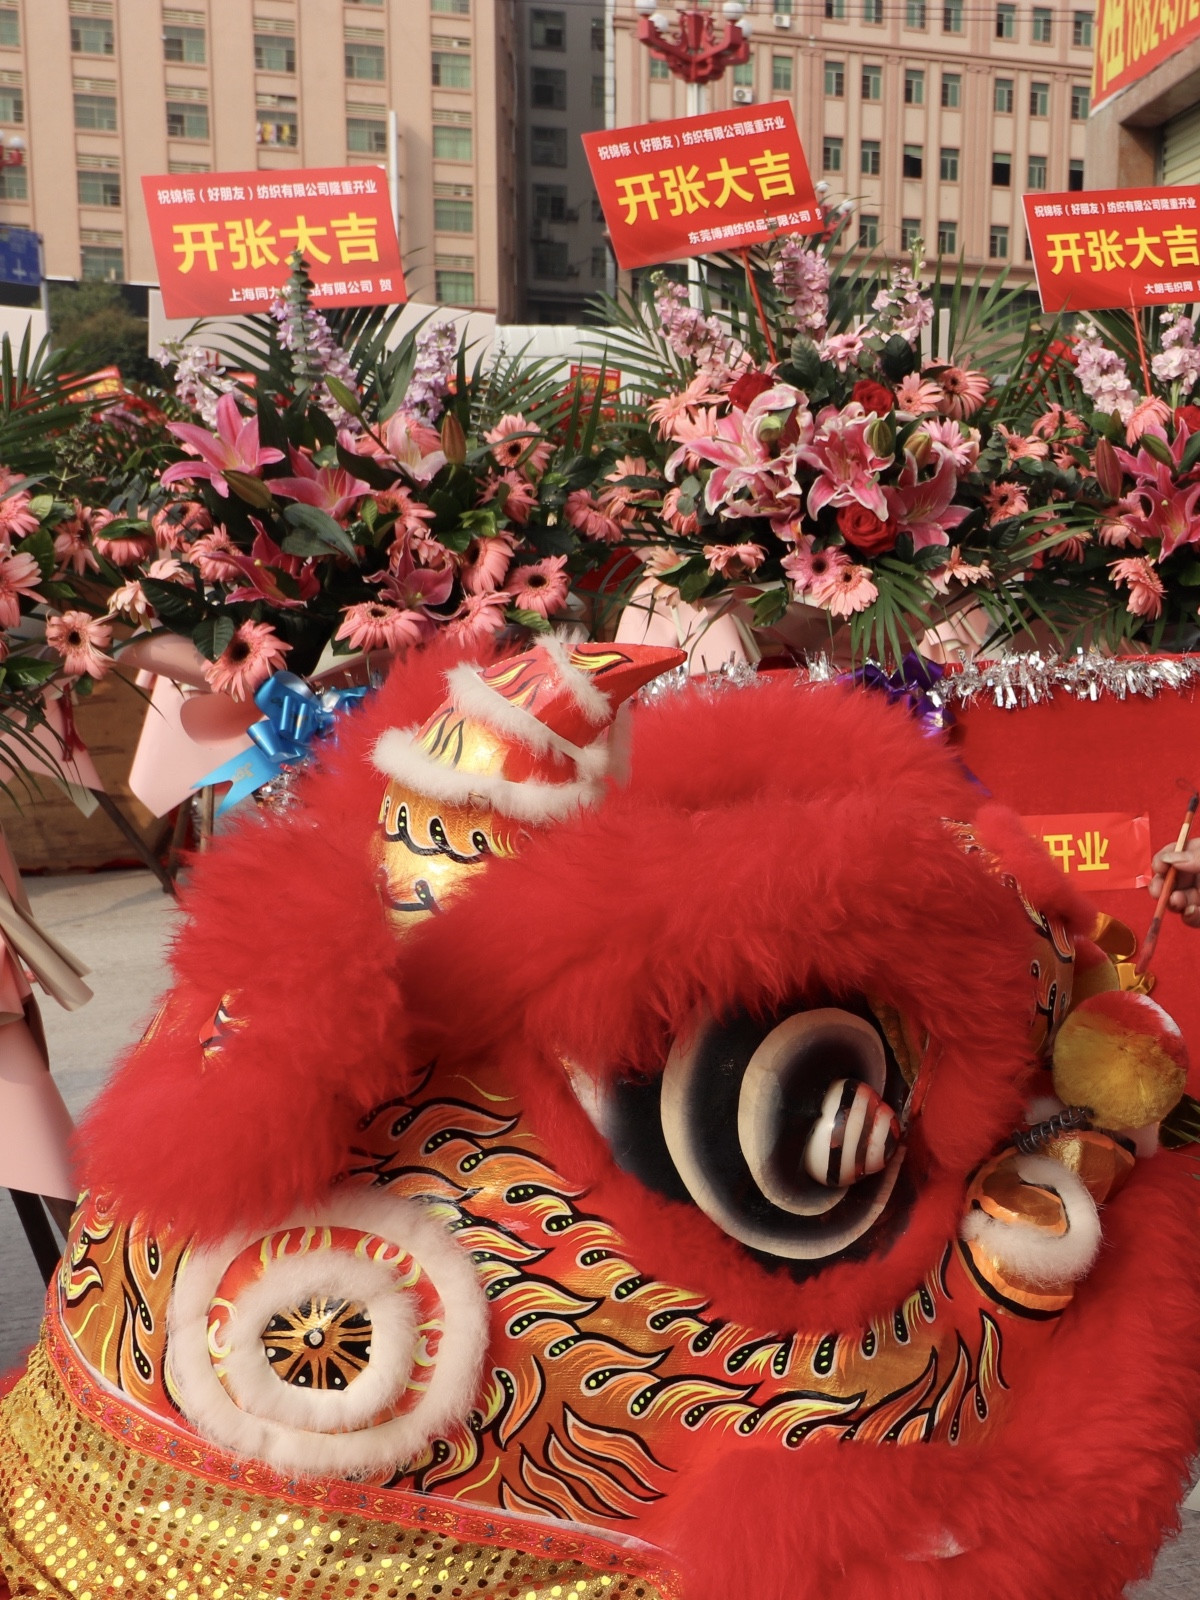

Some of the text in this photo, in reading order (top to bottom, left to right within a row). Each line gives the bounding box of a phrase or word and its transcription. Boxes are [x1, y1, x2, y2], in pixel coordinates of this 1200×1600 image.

[615, 149, 796, 226] 开张大吉
[172, 212, 379, 274] 开张大吉
[1046, 224, 1200, 275] 开张大吉
[1043, 831, 1110, 873] 开业
